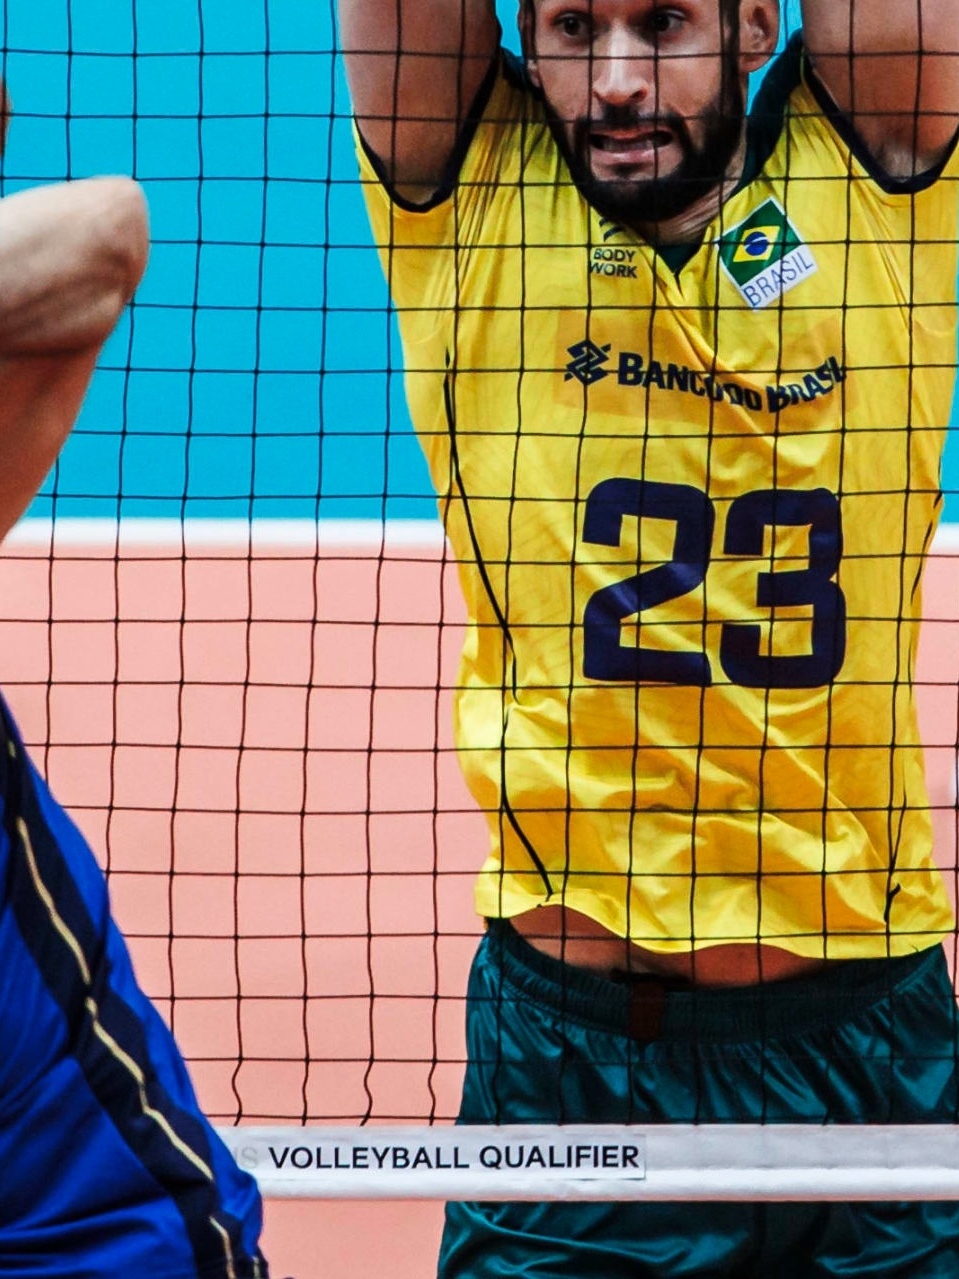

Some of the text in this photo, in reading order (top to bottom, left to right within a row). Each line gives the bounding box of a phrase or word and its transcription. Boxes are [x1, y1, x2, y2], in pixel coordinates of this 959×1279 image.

[591, 261, 638, 279] WORK
[593, 247, 636, 264] BODY
[743, 251, 815, 308] BRASIL
[766, 355, 847, 414] BRASIL
[582, 478, 846, 689] 23
[268, 1146, 470, 1169] VOLLEYBALL
[479, 1145, 640, 1169] QUALIFIER
